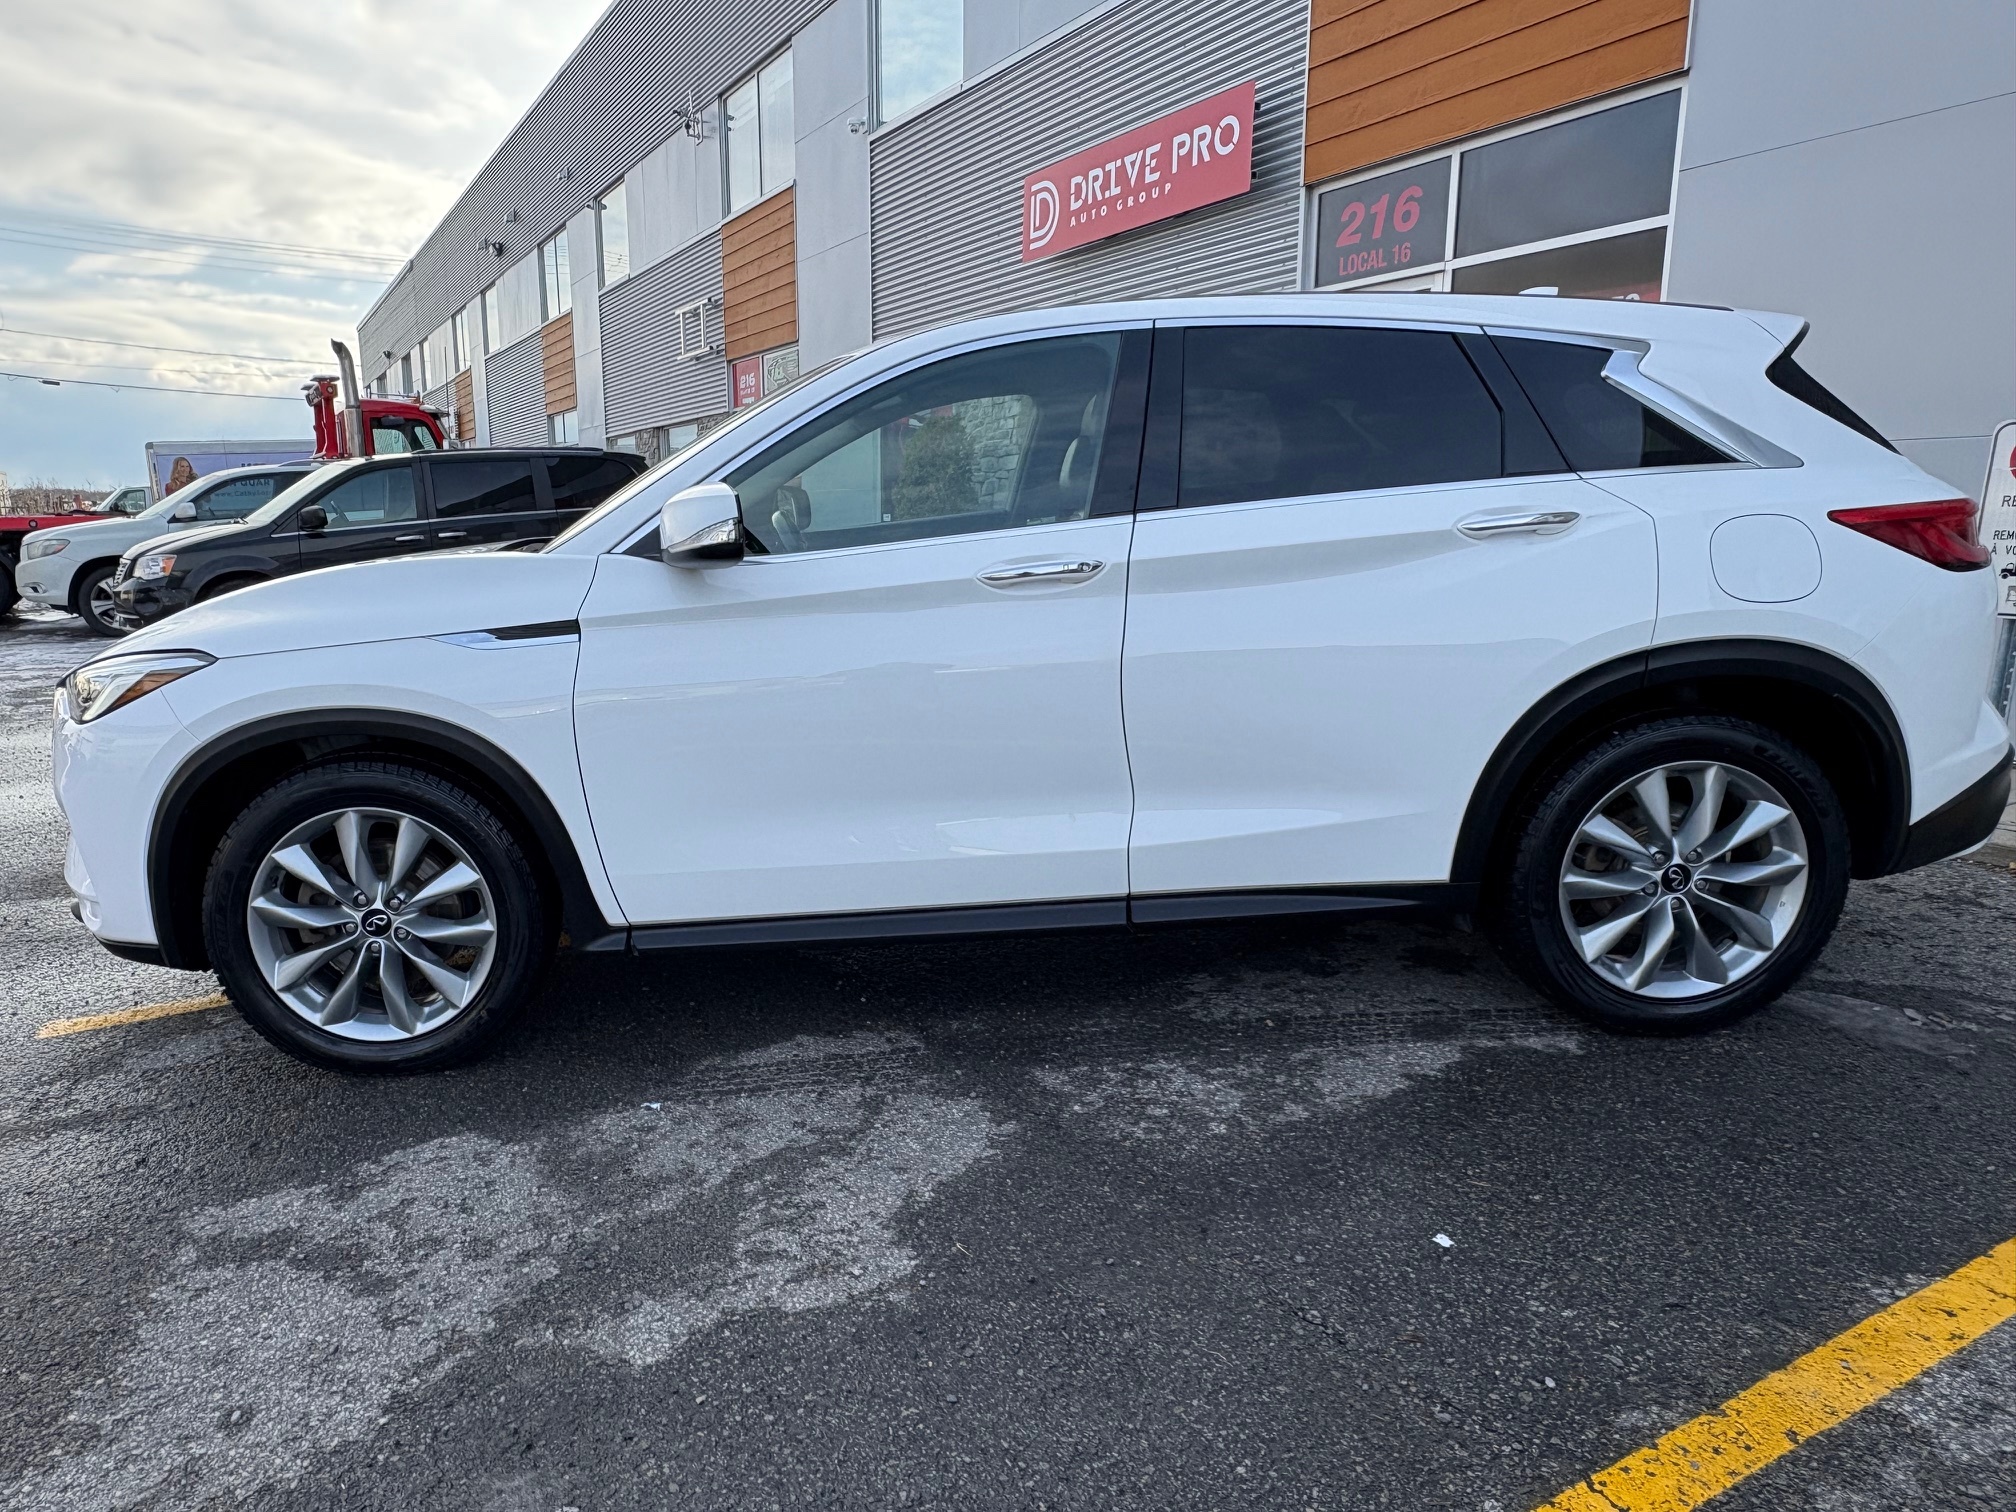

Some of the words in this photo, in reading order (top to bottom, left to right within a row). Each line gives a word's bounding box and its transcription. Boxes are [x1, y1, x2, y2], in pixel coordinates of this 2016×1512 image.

[1070, 142, 1162, 211] DRIVE
[1172, 115, 1240, 174] PRO
[1070, 205, 1108, 227] AUTO
[1116, 182, 1171, 211] GROUP
[1336, 185, 1424, 248] 216
[1339, 248, 1387, 276] LOCAL
[1392, 242, 1411, 264] 16
